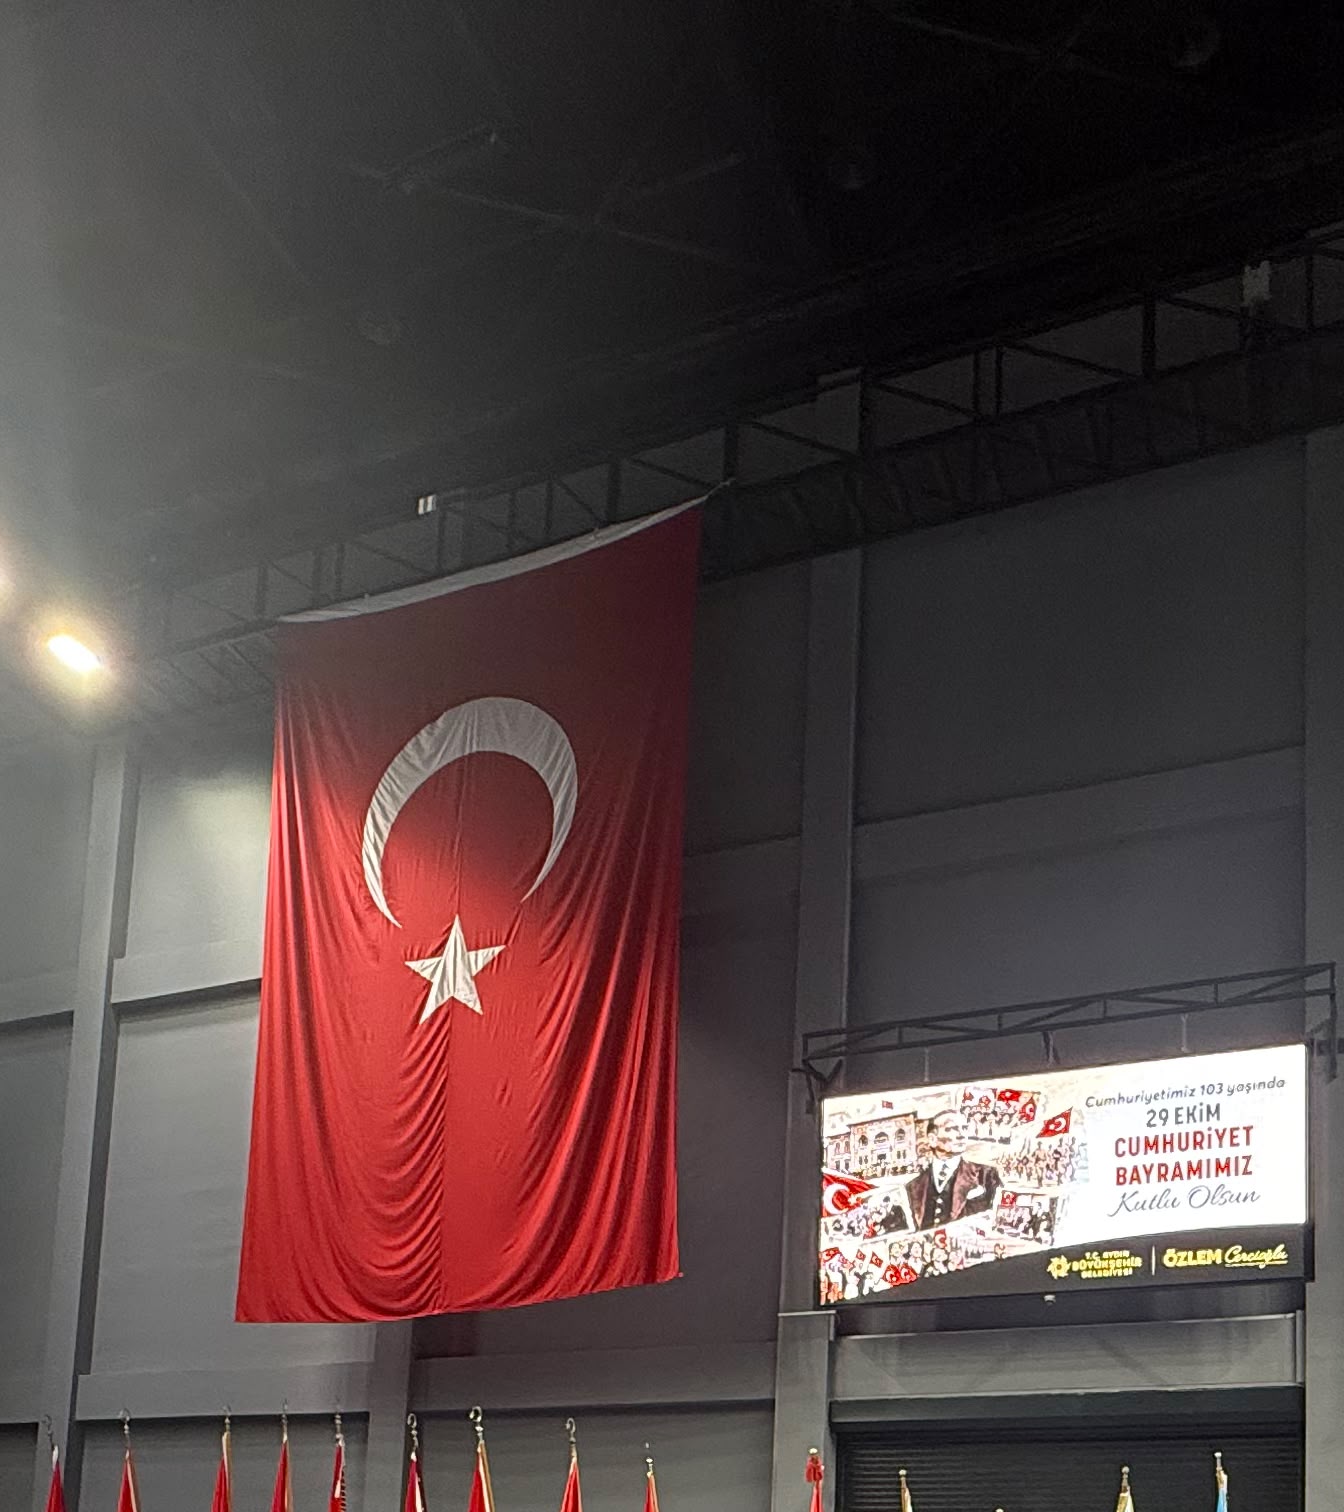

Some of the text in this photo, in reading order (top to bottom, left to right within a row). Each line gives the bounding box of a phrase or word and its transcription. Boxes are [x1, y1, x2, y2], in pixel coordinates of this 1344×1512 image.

[1085, 1076, 1286, 1108] Cumhuriyetimiz 103 yaşında
[1146, 1102, 1221, 1128] 29 EKİM
[1114, 1125, 1254, 1158] CUMHURİYET
[1115, 1154, 1253, 1186] BAYRAMIMIZ
[1107, 1184, 1262, 1217] Kutlu Olsun
[1163, 1248, 1223, 1268] ÖZLEM
